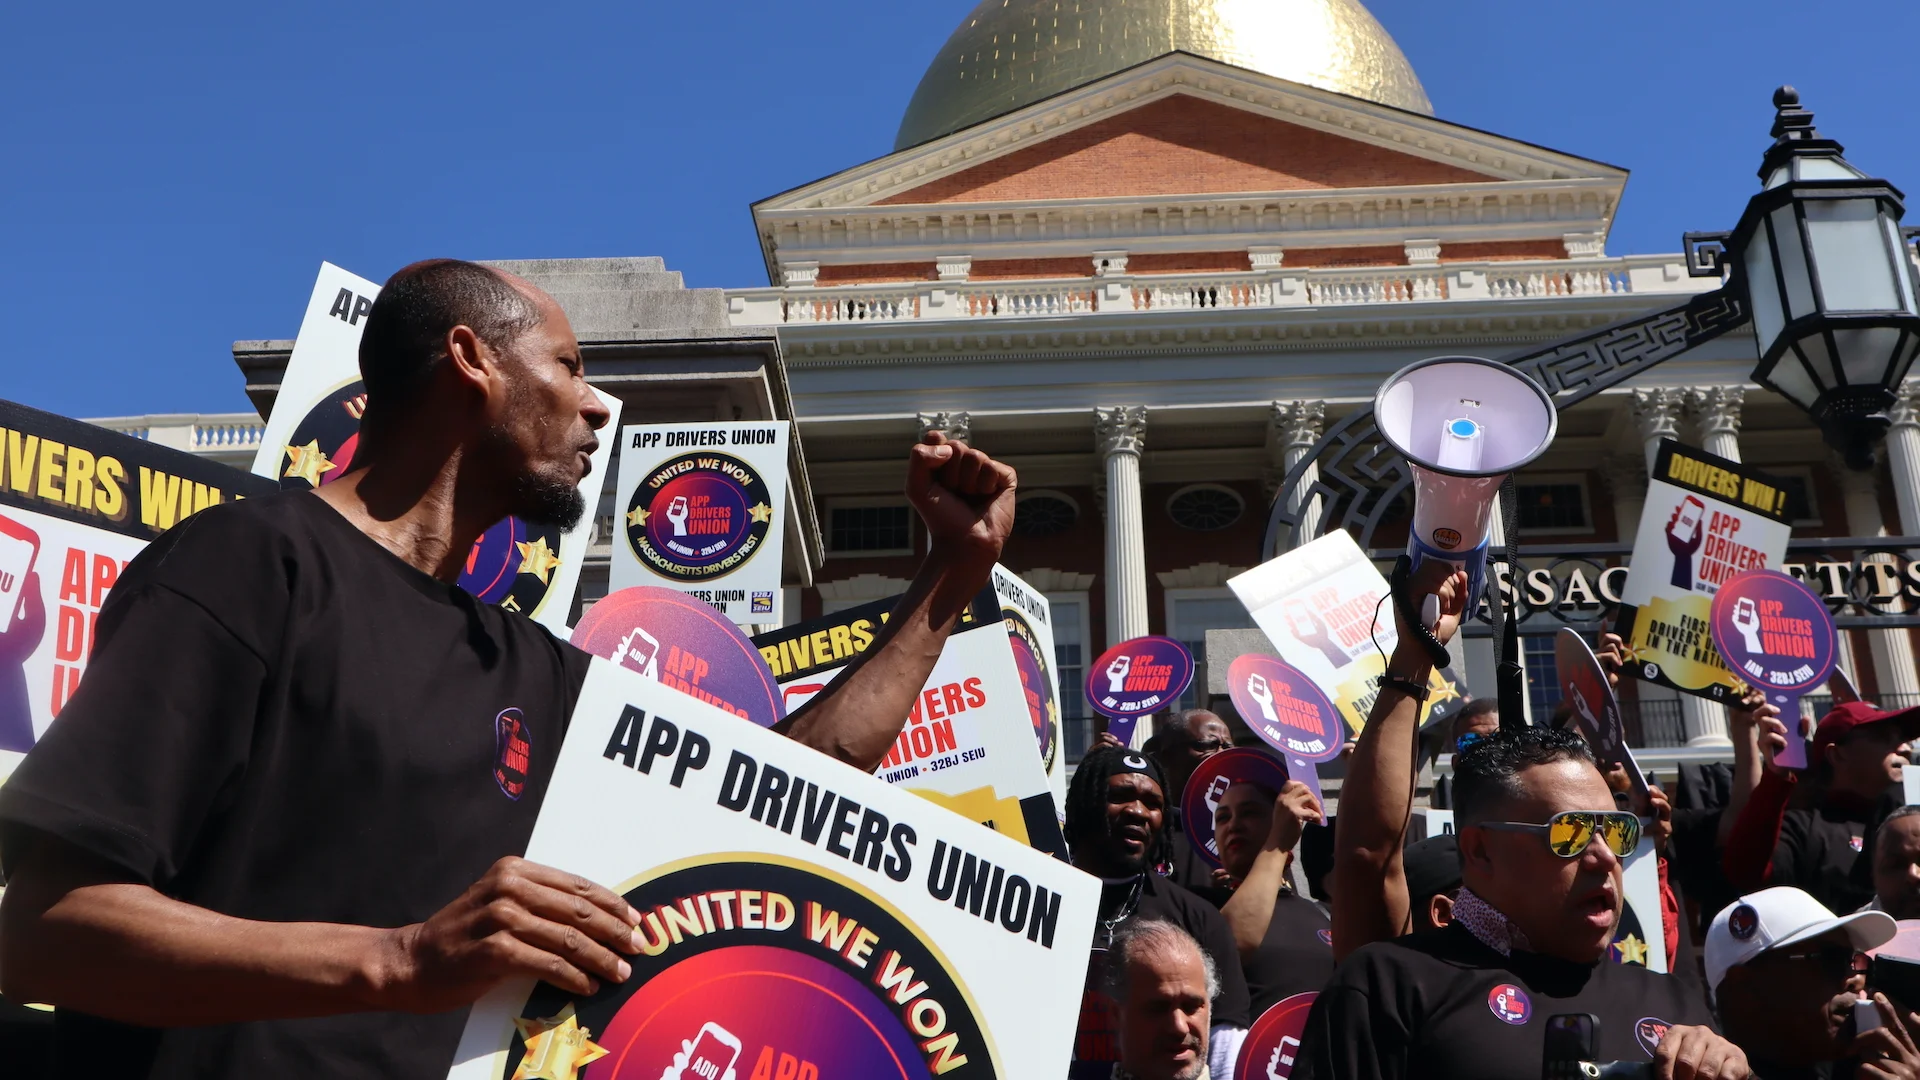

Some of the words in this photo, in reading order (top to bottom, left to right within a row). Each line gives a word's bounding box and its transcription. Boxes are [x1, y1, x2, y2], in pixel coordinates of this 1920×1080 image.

[329, 287, 373, 326] AP
[632, 433, 661, 449] APP
[666, 430, 727, 447] DRIVERS
[732, 429, 776, 445] UNION
[648, 460, 695, 489] UNITED
[697, 458, 720, 470] WE
[721, 461, 754, 487] WON
[1668, 453, 1741, 499] DRIVERS
[1742, 478, 1776, 512] WIN
[690, 495, 710, 507] APP
[690, 507, 732, 519] DRIVERS
[689, 518, 730, 535] UNION
[1708, 510, 1742, 539] APP
[637, 535, 702, 575] MASSACHUSETTS
[703, 552, 741, 575] DRIVERS
[737, 534, 758, 557] FIRST
[1704, 533, 1768, 570] DRIVERS
[59, 547, 131, 608] AP
[1699, 556, 1738, 586] UNIO
[715, 590, 745, 601] UNION
[994, 571, 1025, 609] DRIVERS
[1025, 593, 1046, 625] UNION
[1310, 586, 1340, 612] APP
[1760, 599, 1783, 616] APP
[1323, 590, 1384, 630] DRIVERS
[1336, 615, 1384, 648] UNION
[1649, 619, 1701, 646] DRIVERS
[1761, 616, 1812, 636] DRIVERS
[629, 647, 647, 665] ADU
[758, 619, 874, 677] RIVERS
[1646, 633, 1660, 649] IN
[1667, 639, 1689, 658] THE
[1763, 632, 1816, 659] UNION
[664, 645, 709, 686] APP
[1129, 665, 1173, 677] DRIVERS
[1132, 655, 1154, 665] APP
[1744, 659, 1763, 678] IAM
[1770, 670, 1795, 685] 32BJ
[1793, 664, 1814, 683] SEIU
[1125, 677, 1169, 692] UNION
[1271, 679, 1291, 696] APP
[907, 677, 986, 726] VERS
[1102, 696, 1118, 708] IAM
[1120, 701, 1140, 711] 32BJ
[1142, 695, 1160, 708] SEIU
[1274, 692, 1320, 717] DRIVERS
[1264, 724, 1281, 741] IAM
[1277, 705, 1325, 736] UNION
[882, 719, 957, 769] NION
[887, 766, 919, 784] UNION
[931, 755, 960, 772] 32BJ
[962, 747, 986, 763] SEIU
[603, 703, 711, 789] APP
[717, 749, 917, 882] DRIVERS
[927, 839, 1062, 950] UNION
[634, 889, 796, 957] UNITED
[804, 900, 880, 969] WE
[874, 949, 969, 1076] WON
[691, 1056, 720, 1080] ADU
